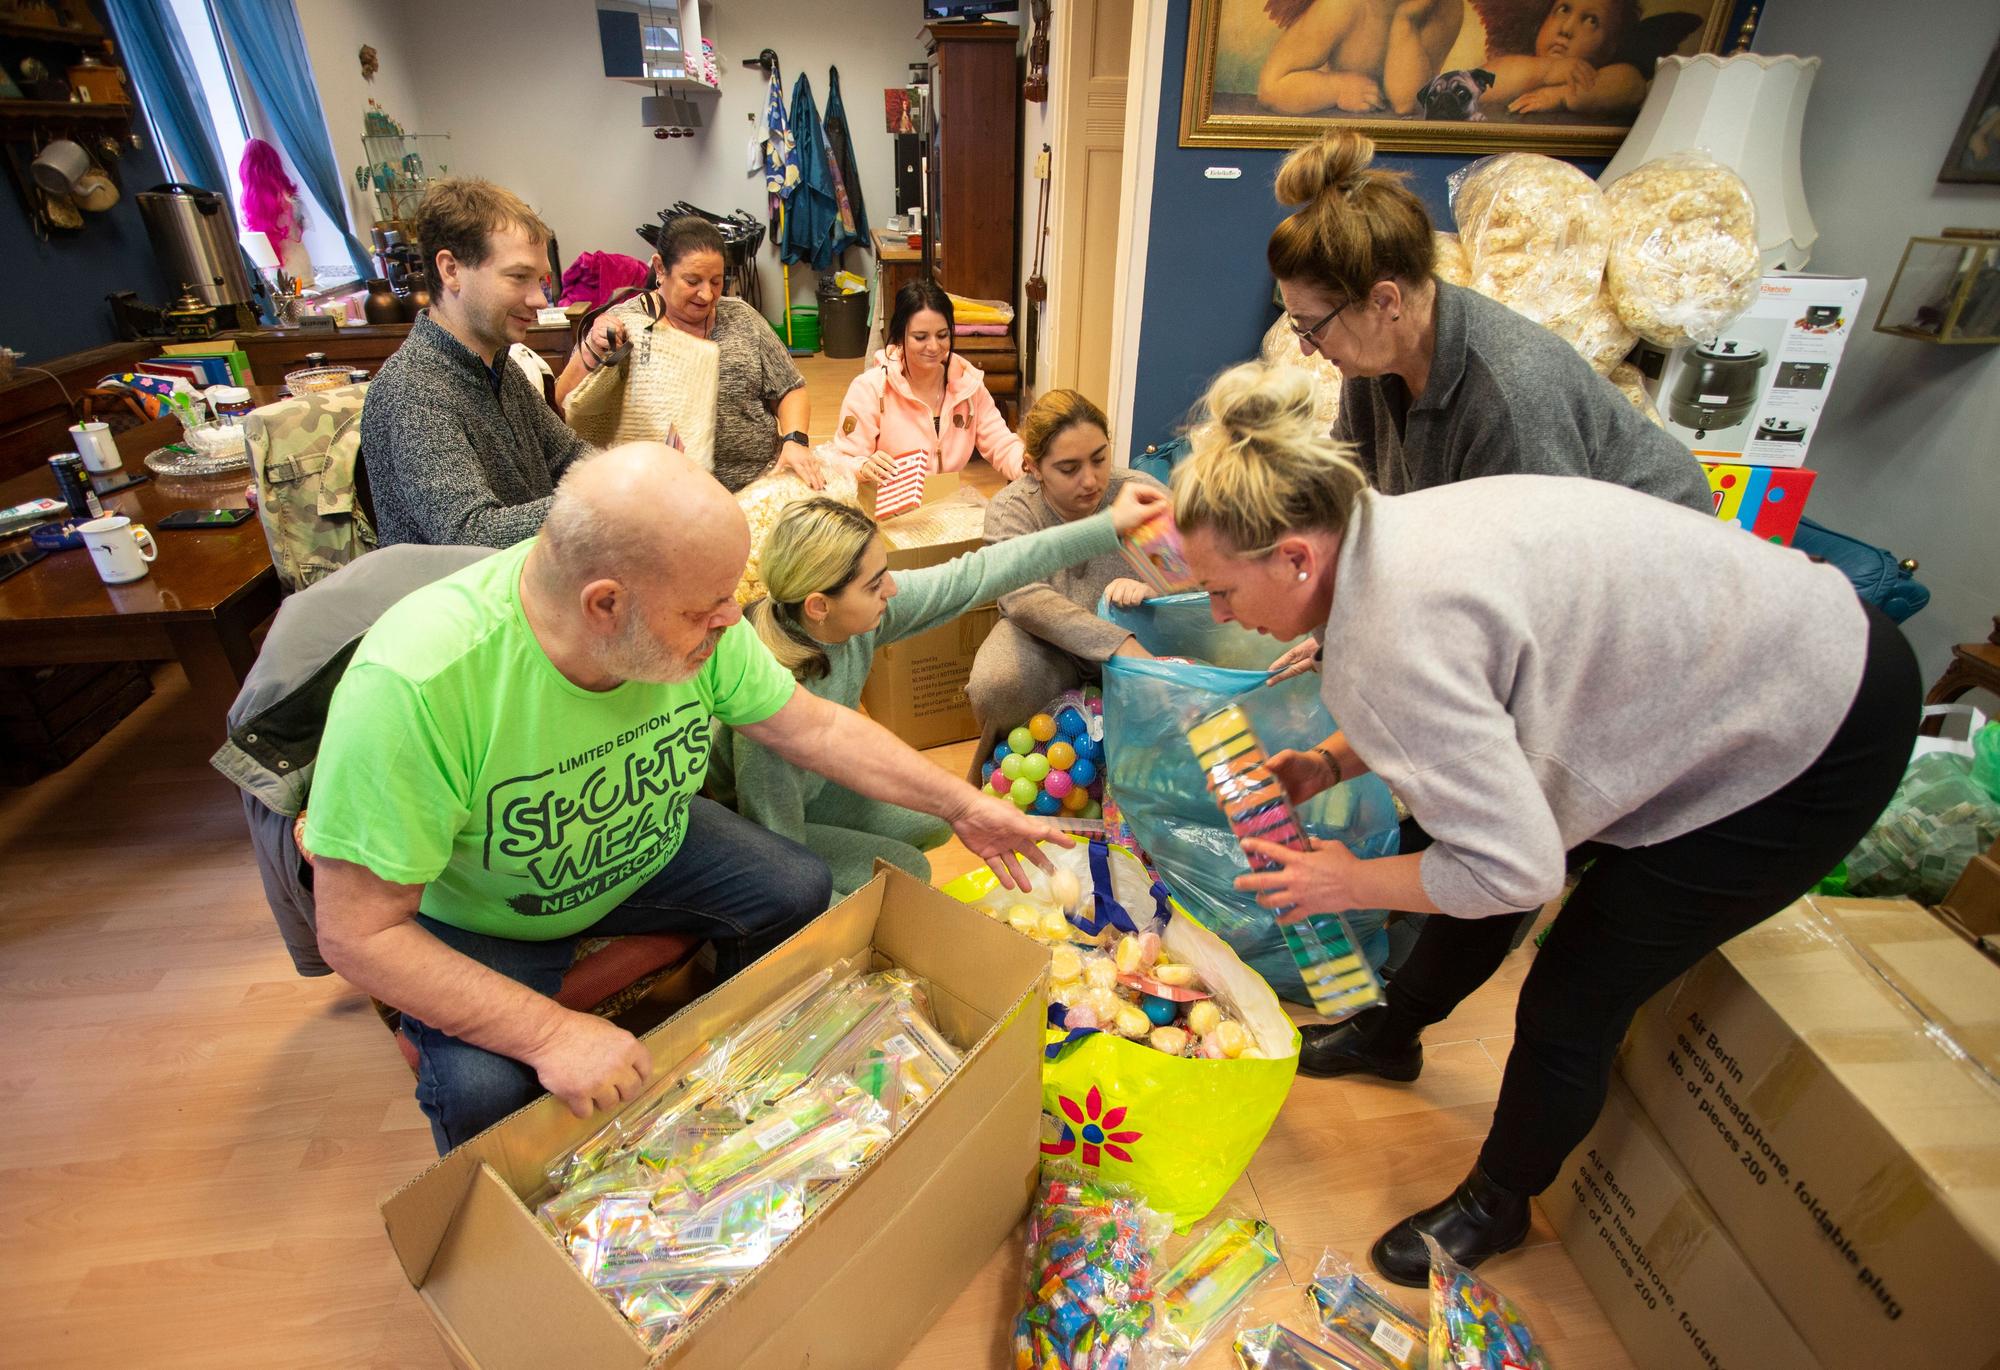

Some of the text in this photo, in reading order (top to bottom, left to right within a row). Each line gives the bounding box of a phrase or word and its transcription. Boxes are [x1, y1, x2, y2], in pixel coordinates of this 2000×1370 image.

[500, 713, 712, 857] SPORTS
[559, 712, 671, 774] LIMITED EDITION
[541, 881, 598, 913] NEW
[1687, 1012, 1744, 1084] Air Berlin
[1667, 1051, 1767, 1185] No. of pieces 200
[1677, 1033, 1904, 1321] earclip headphone, foldable plug
[1571, 1180, 1657, 1310] No. of pieces 200
[1580, 1166, 1612, 1216] earclip
[1613, 1214, 1675, 1313] headphone,
[1587, 1150, 1636, 1219] Air Berlin
